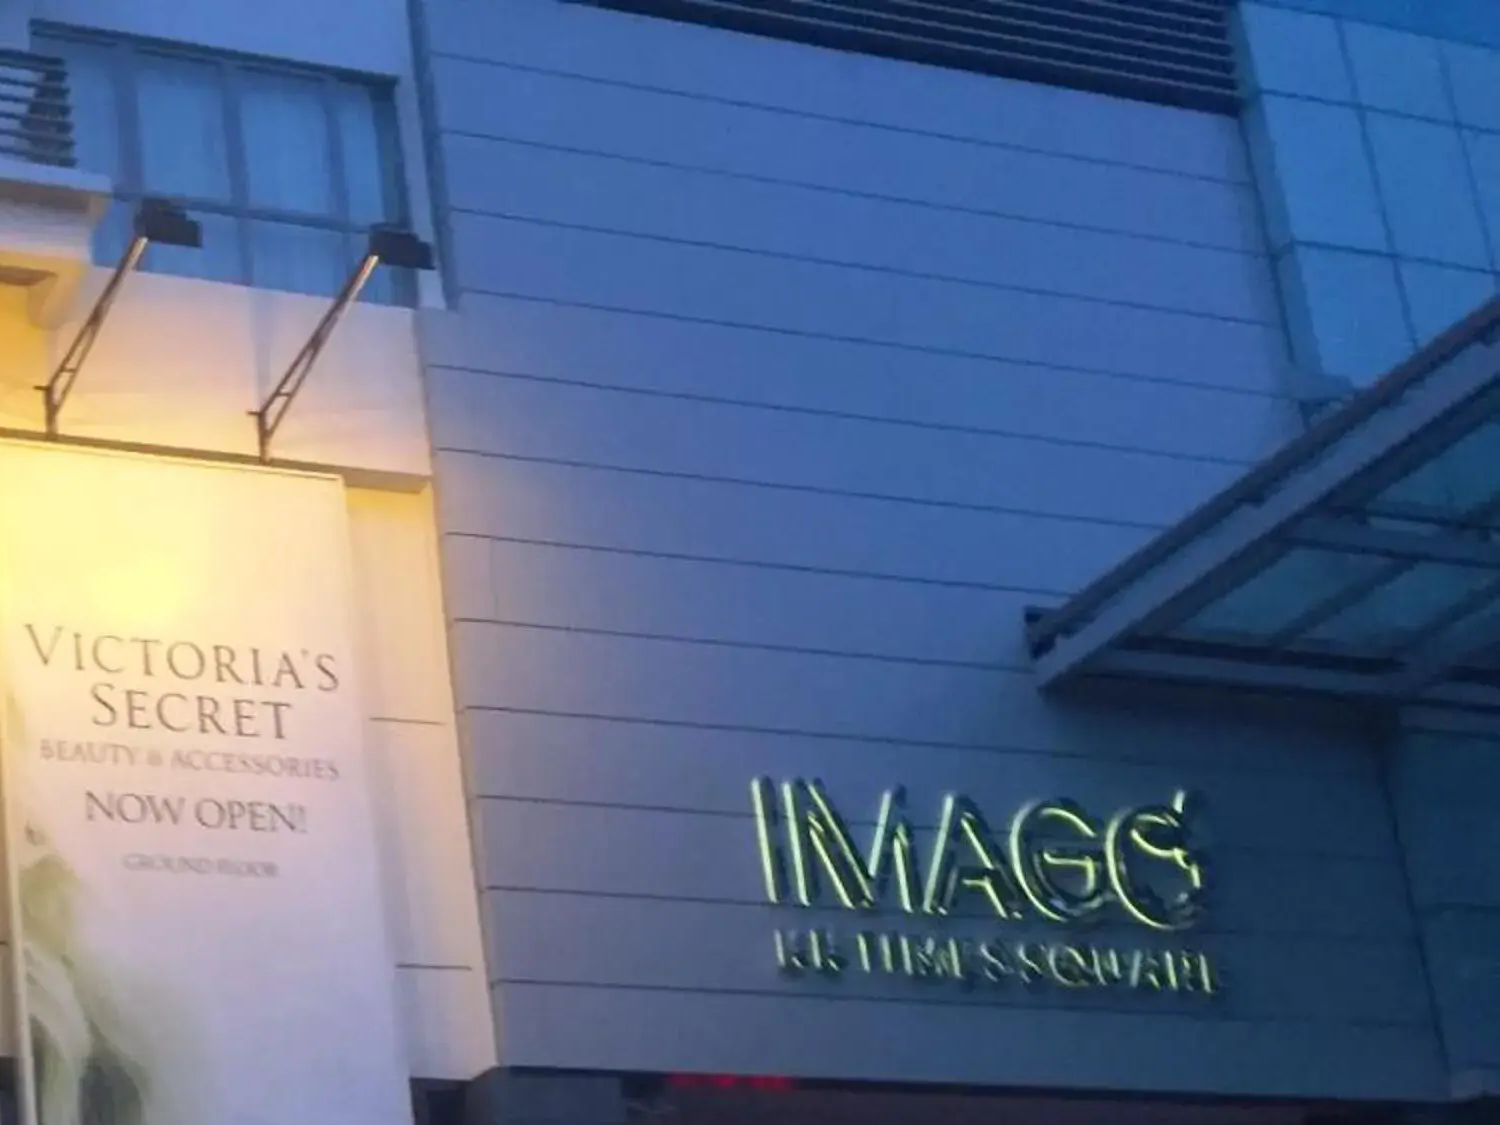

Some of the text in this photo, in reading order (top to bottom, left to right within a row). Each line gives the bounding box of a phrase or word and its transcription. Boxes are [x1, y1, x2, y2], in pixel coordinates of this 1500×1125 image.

[23, 622, 341, 693] VICTORIA'S
[89, 682, 293, 740] SECRET
[40, 738, 139, 767] BEAUTY
[170, 747, 341, 782] ACCESSORIES
[84, 788, 309, 834] NOW OPEN!
